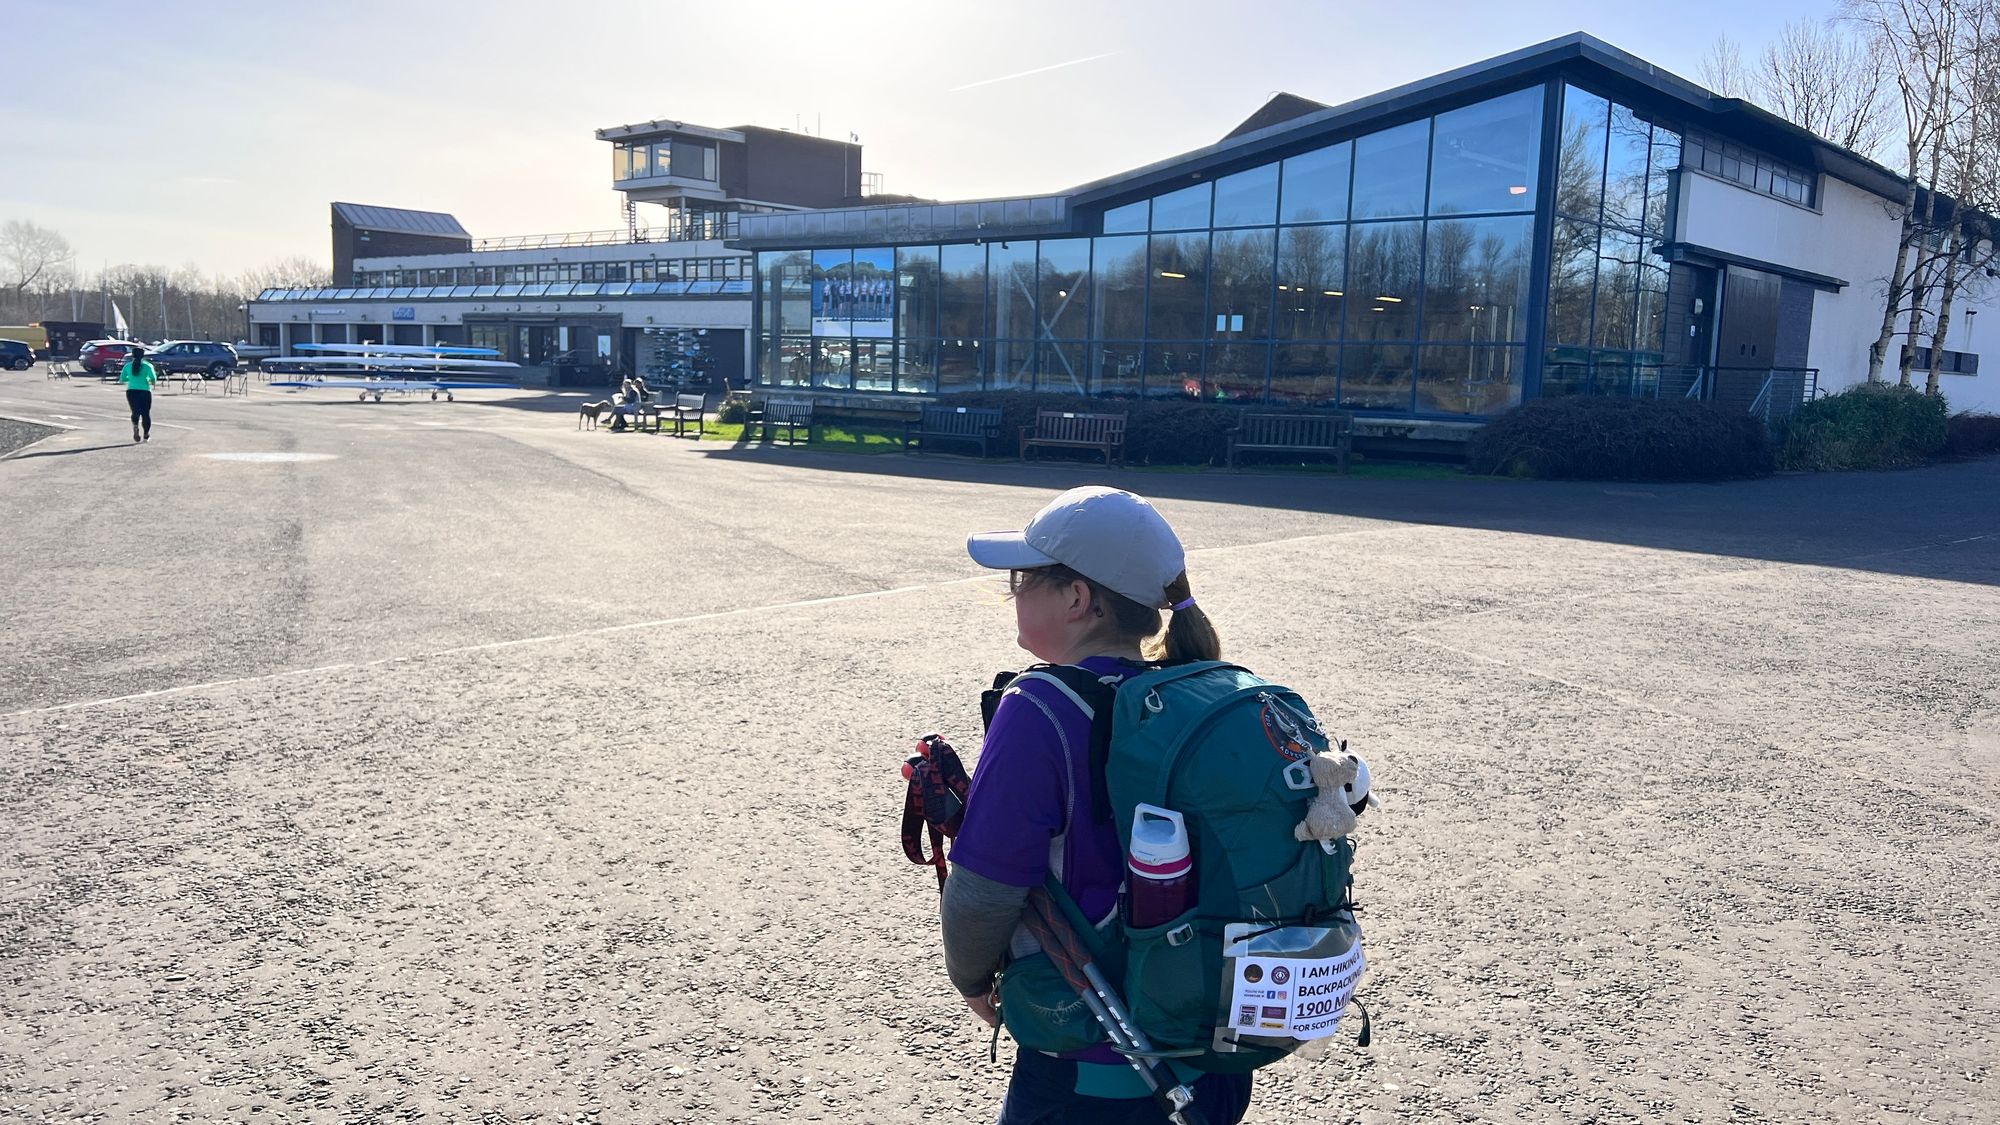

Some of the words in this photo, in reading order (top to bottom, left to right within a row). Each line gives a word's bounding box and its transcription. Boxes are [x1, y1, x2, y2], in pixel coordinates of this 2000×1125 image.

[1302, 967, 1306, 978] I
[1308, 966, 1329, 979] AM
[1331, 953, 1357, 976] HIKING
[1298, 965, 1362, 997] BACKPACKING
[1296, 999, 1332, 1017] 1900
[1293, 1024, 1310, 1032] FOR
